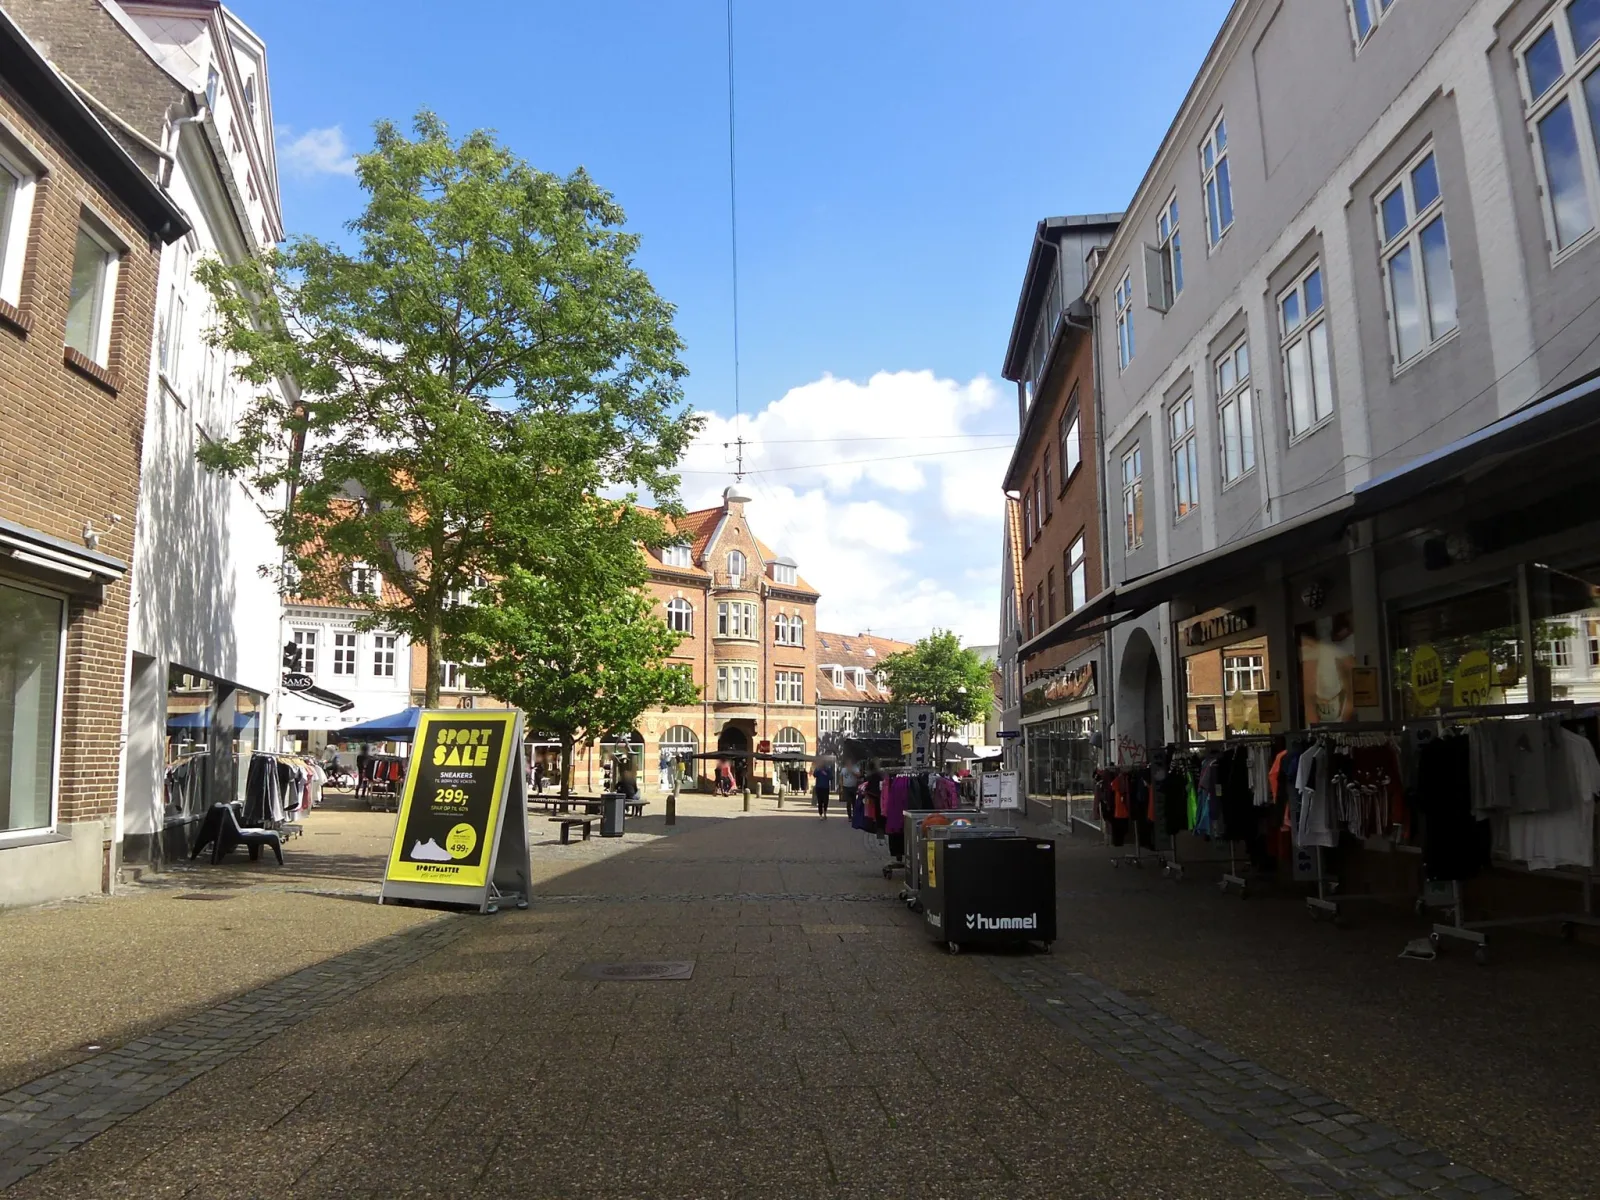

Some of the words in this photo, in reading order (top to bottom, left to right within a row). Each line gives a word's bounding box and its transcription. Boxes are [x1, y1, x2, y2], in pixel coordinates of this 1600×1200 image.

[437, 728, 493, 745] SPORT
[433, 745, 489, 767] SALE
[977, 912, 1037, 929] hummel
